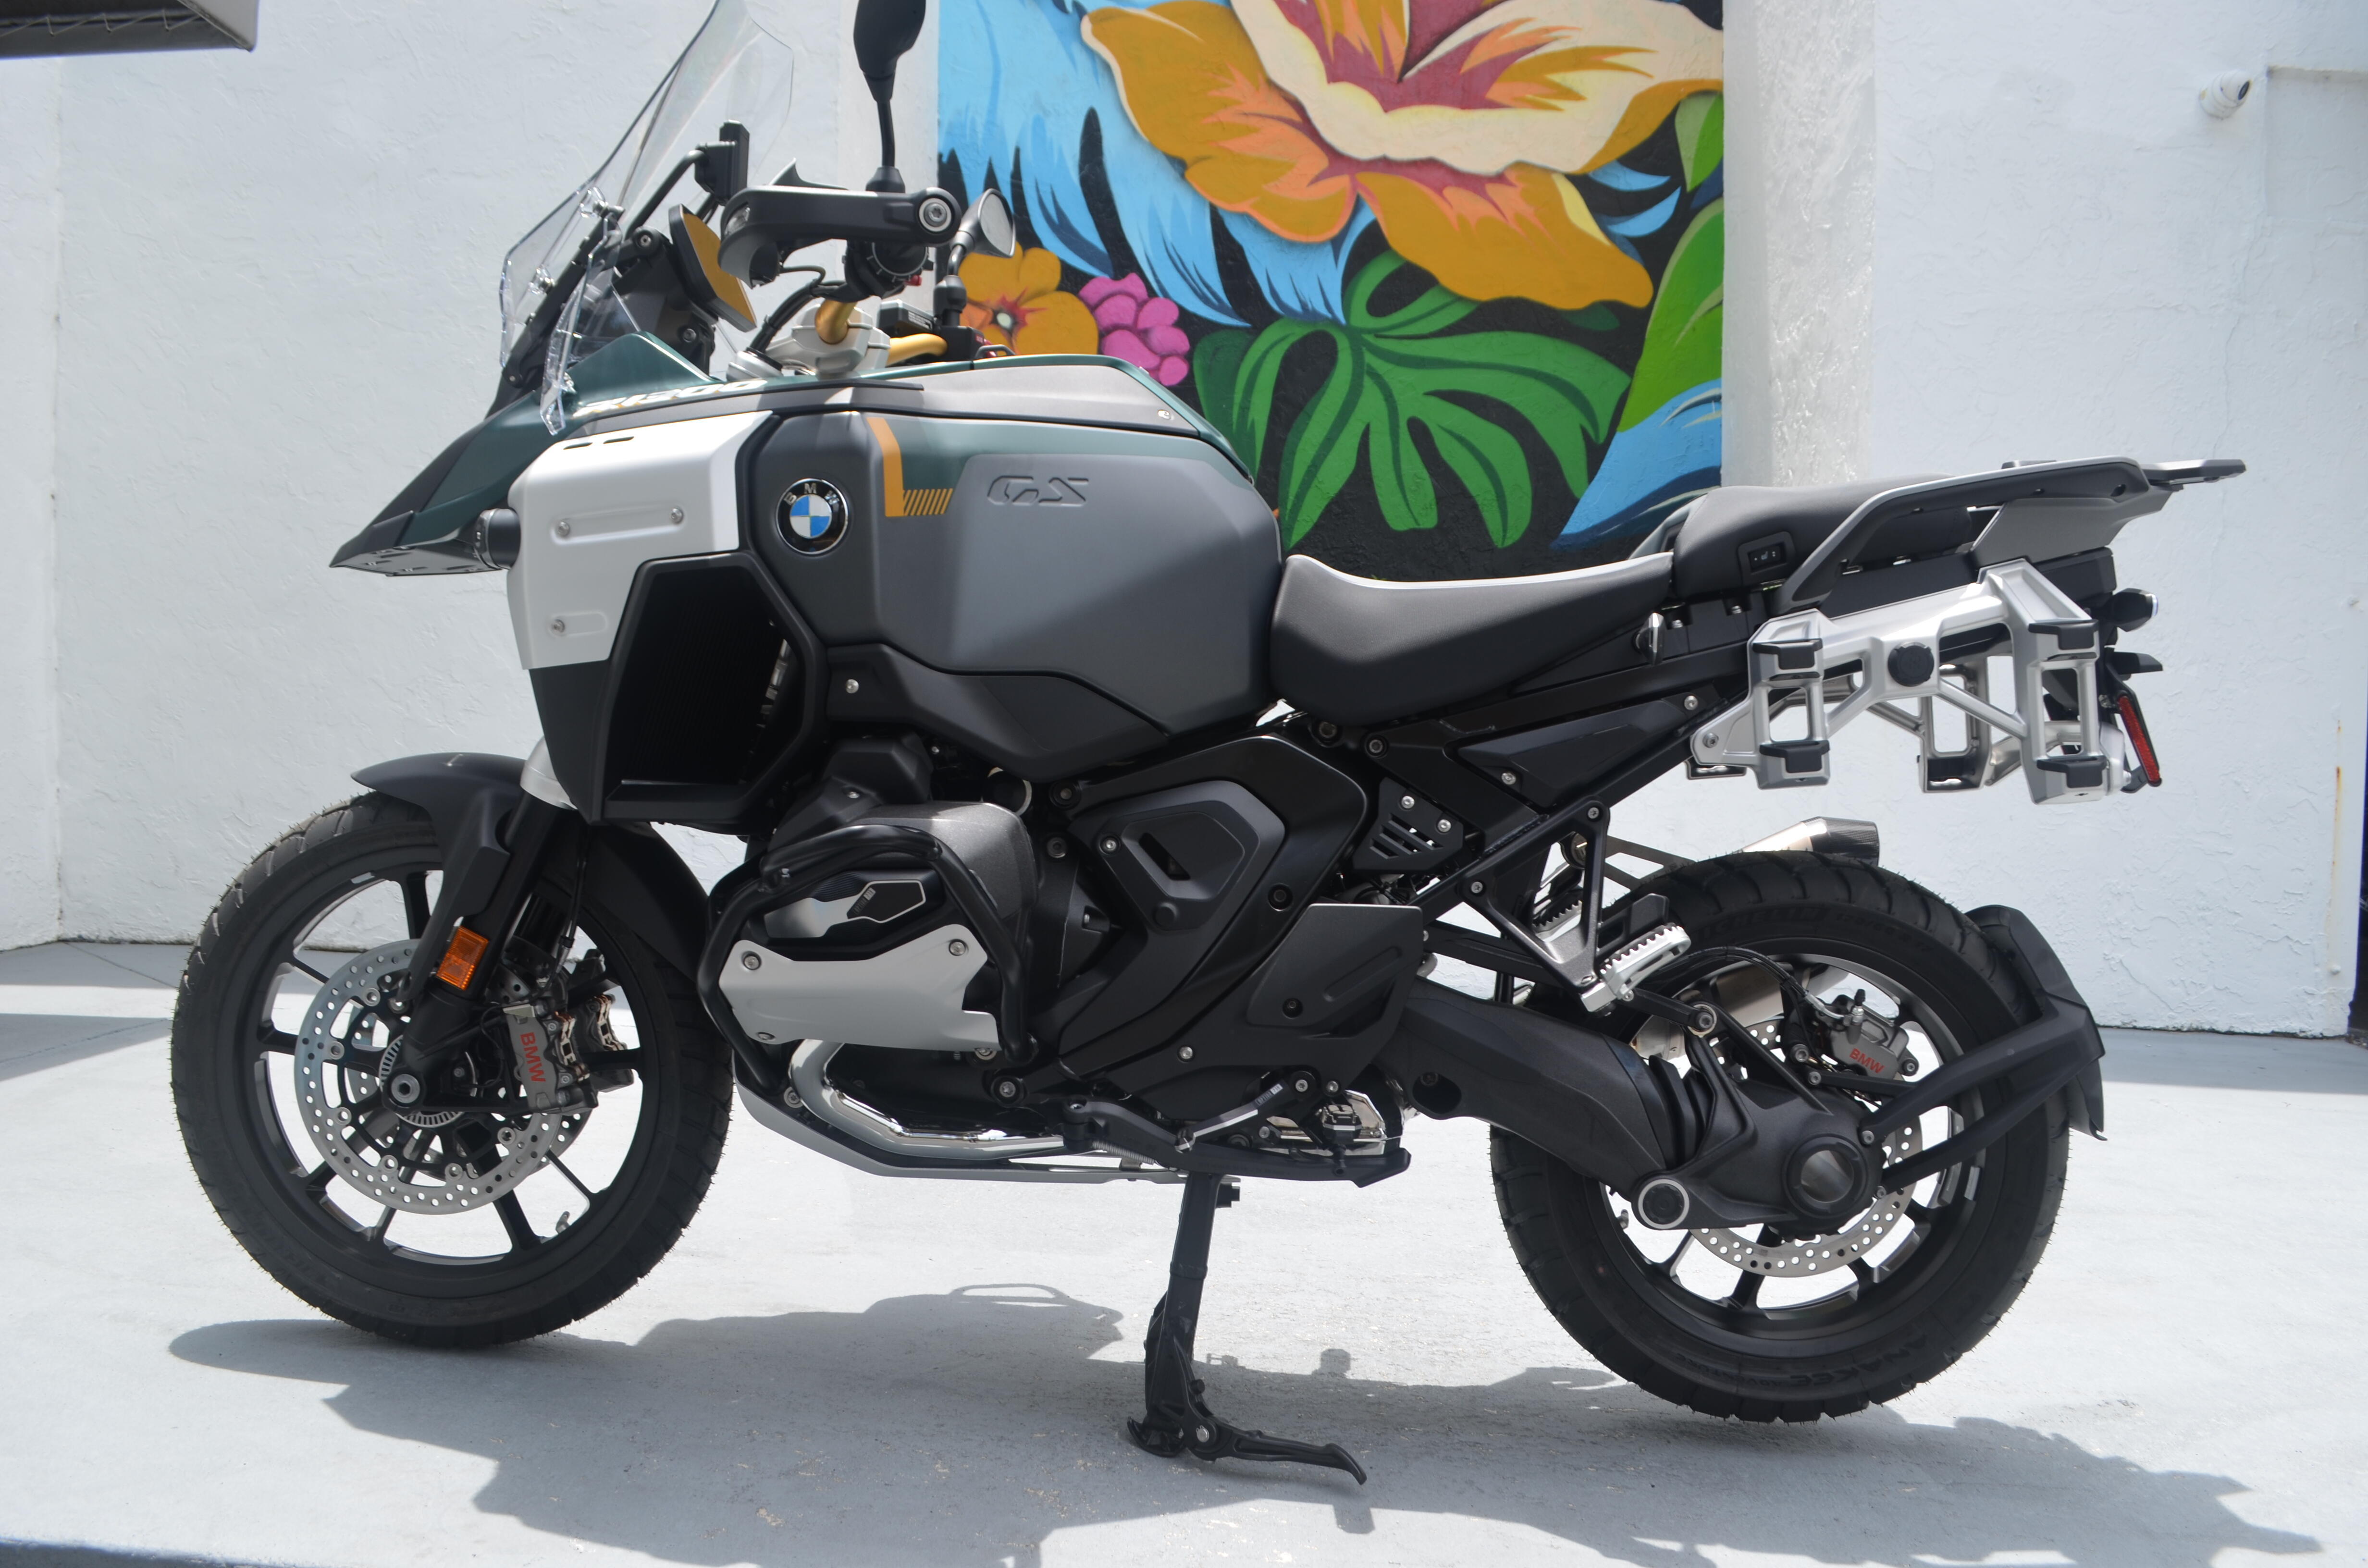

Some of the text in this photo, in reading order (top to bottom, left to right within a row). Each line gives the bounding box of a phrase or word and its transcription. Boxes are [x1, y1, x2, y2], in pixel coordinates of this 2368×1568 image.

[783, 482, 840, 505] BMW
[987, 476, 1089, 506] GS
[519, 1032, 546, 1083] BMW
[1849, 1048, 1885, 1074] BMW
